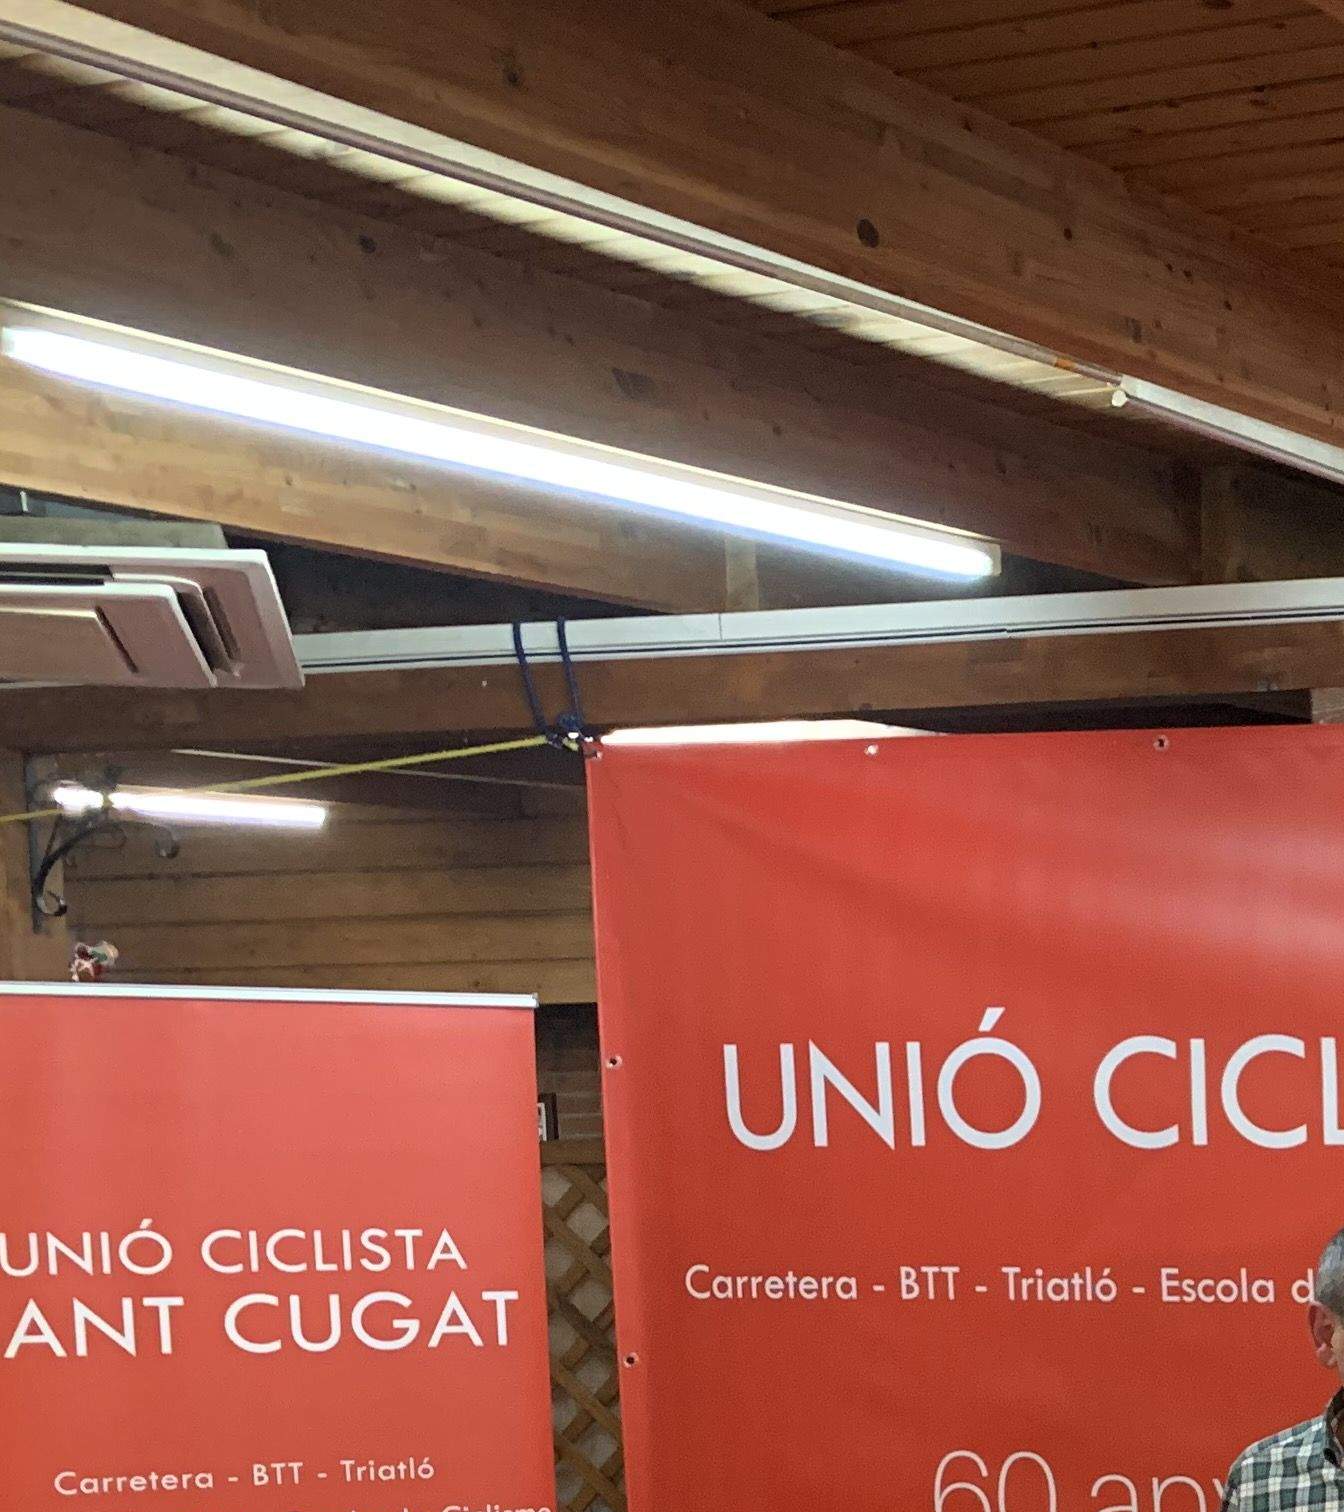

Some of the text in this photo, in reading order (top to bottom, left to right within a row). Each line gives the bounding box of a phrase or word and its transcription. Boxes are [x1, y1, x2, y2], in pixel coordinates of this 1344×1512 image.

[723, 1006, 1042, 1151] UNIÓ
[0, 1218, 468, 1277] UNIÓ CICLISTA
[685, 1264, 858, 1300] Carretera
[899, 1265, 961, 1301] BTT
[1001, 1266, 1118, 1302] Triatló
[1160, 1267, 1275, 1304] Escola
[1291, 1267, 1316, 1304] d
[4, 1290, 519, 1359] ANT CUGAT
[53, 1471, 214, 1496] Carretera
[252, 1461, 304, 1486] BTT
[339, 1456, 435, 1482] Triatló
